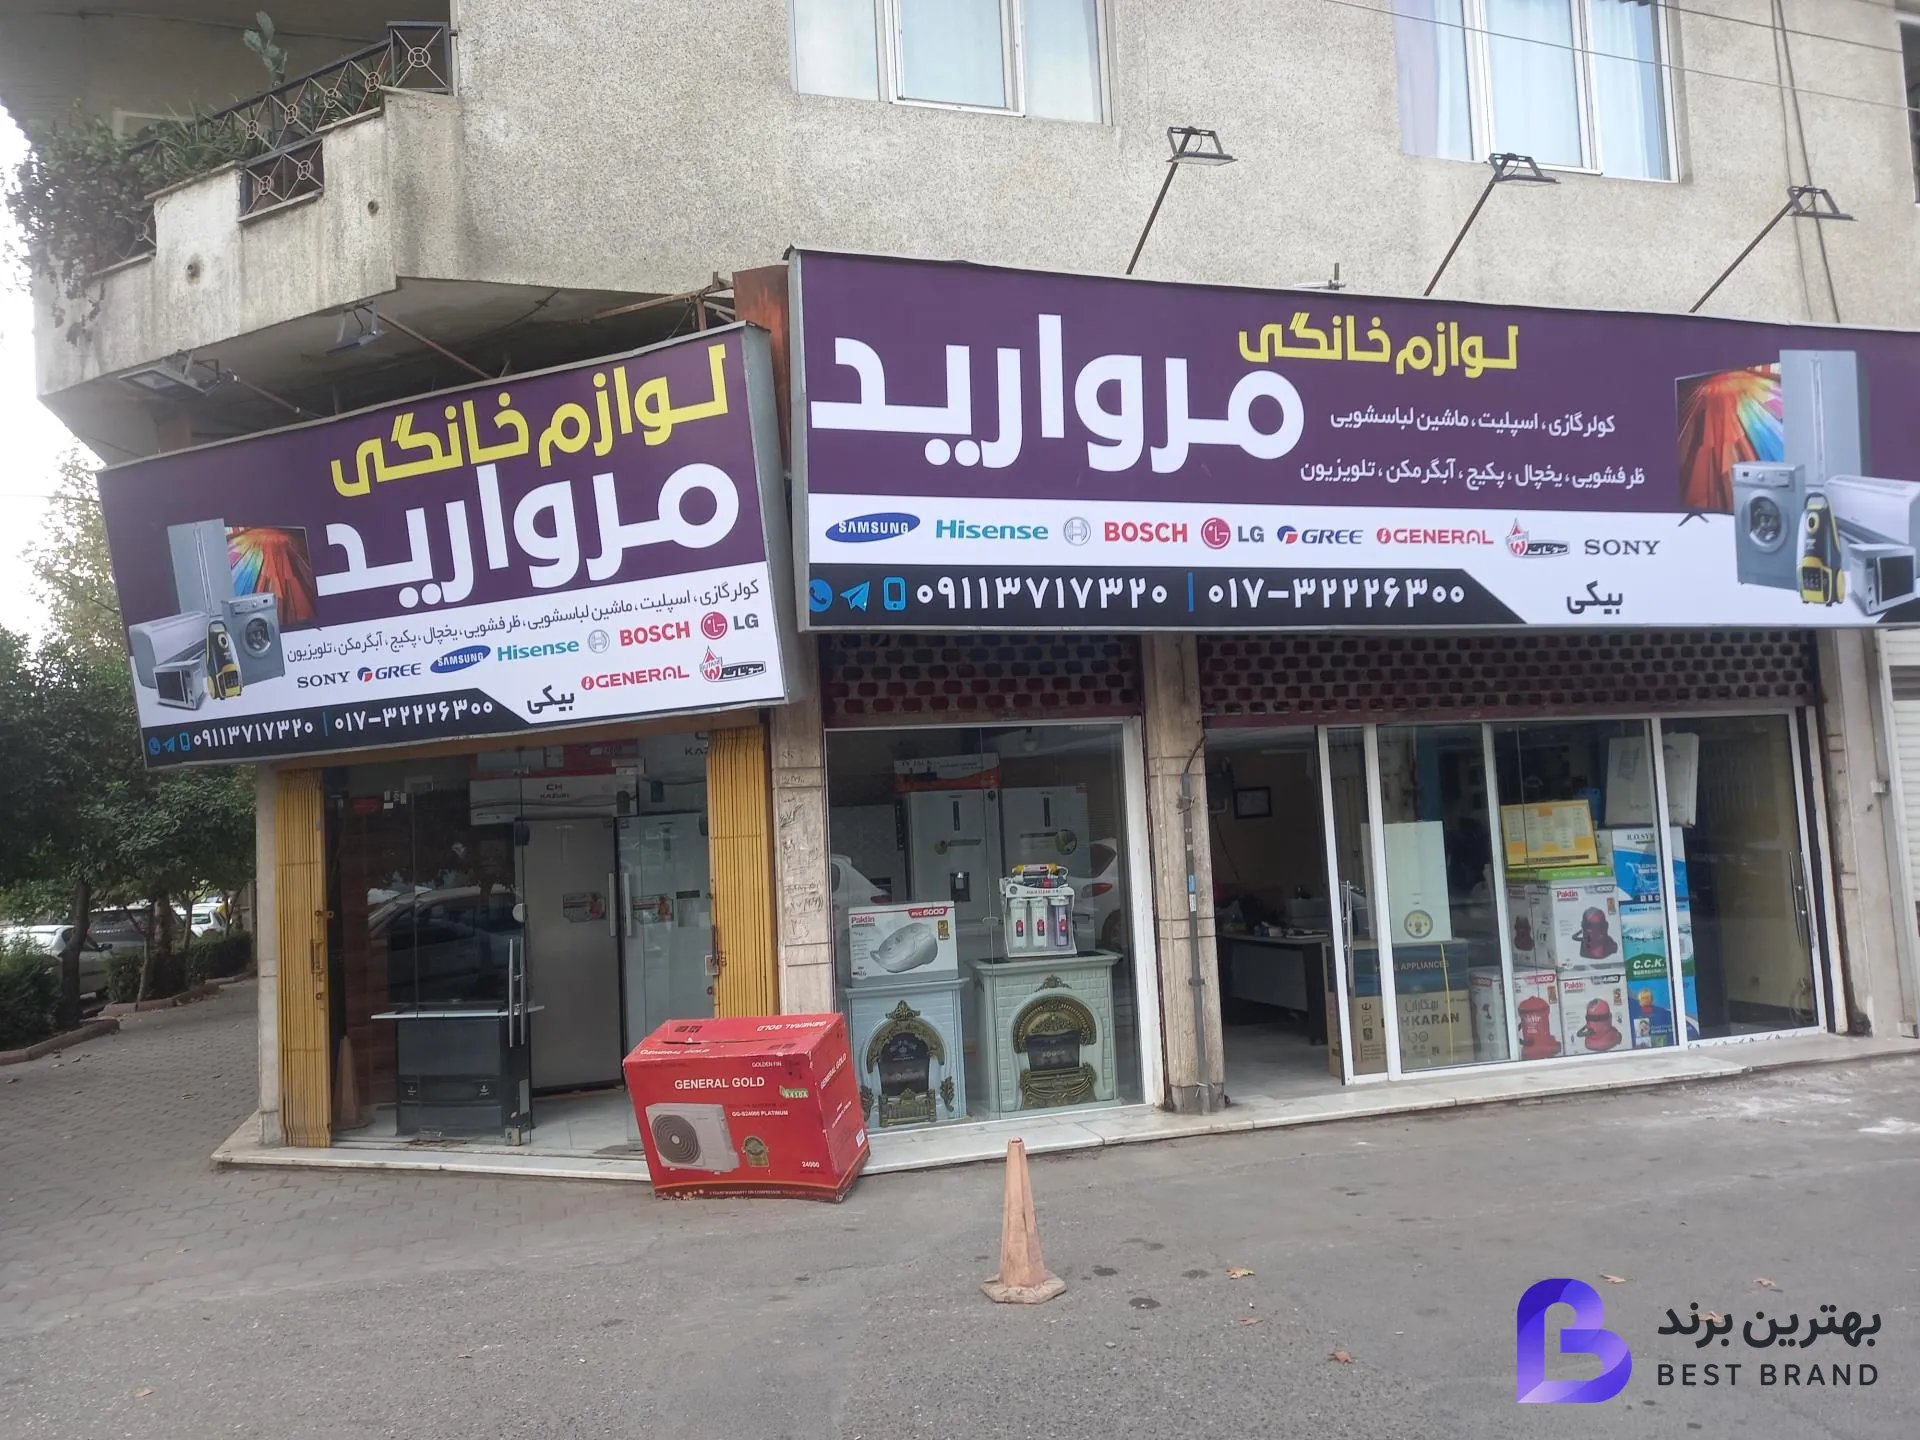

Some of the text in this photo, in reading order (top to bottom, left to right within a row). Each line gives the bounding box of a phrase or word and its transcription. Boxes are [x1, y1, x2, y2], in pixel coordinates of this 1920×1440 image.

[1238, 311, 1519, 379] لوازم خانگی
[810, 313, 1305, 474] مروارید
[330, 343, 729, 498] لوازم خانگی
[1330, 404, 1414, 430] لباسشویی
[1416, 408, 1469, 432] ماشین
[1299, 458, 1376, 483] تلویزیون
[314, 462, 740, 609] مروارید
[935, 519, 1049, 540] Hisense
[1103, 521, 1189, 543] BOSCH
[1237, 525, 1265, 543] LG
[1301, 529, 1365, 545] GREE
[1393, 528, 1494, 545] GENERAL
[1584, 539, 1661, 556] SONY
[916, 575, 1168, 610] ۰۹۱۱۳۷۱۷۳۲۰
[1207, 576, 1465, 609] ۰۱۷-۳۲۲۲۶۳۰۰
[1566, 580, 1624, 615] بیکی
[591, 600, 633, 621] ماشین
[287, 641, 333, 663] تلویزیون
[297, 670, 351, 689] SONY
[375, 662, 422, 681] GREE
[497, 640, 580, 662] Hisense
[619, 620, 691, 647] BOSCH
[733, 612, 759, 631] LG
[595, 665, 690, 689] GENERAL
[526, 684, 576, 715] بیکی
[193, 720, 314, 747] ۰۹۱۱۳۷۱۷۳۲۰
[674, 1076, 765, 1090] GENERAL GOLD
